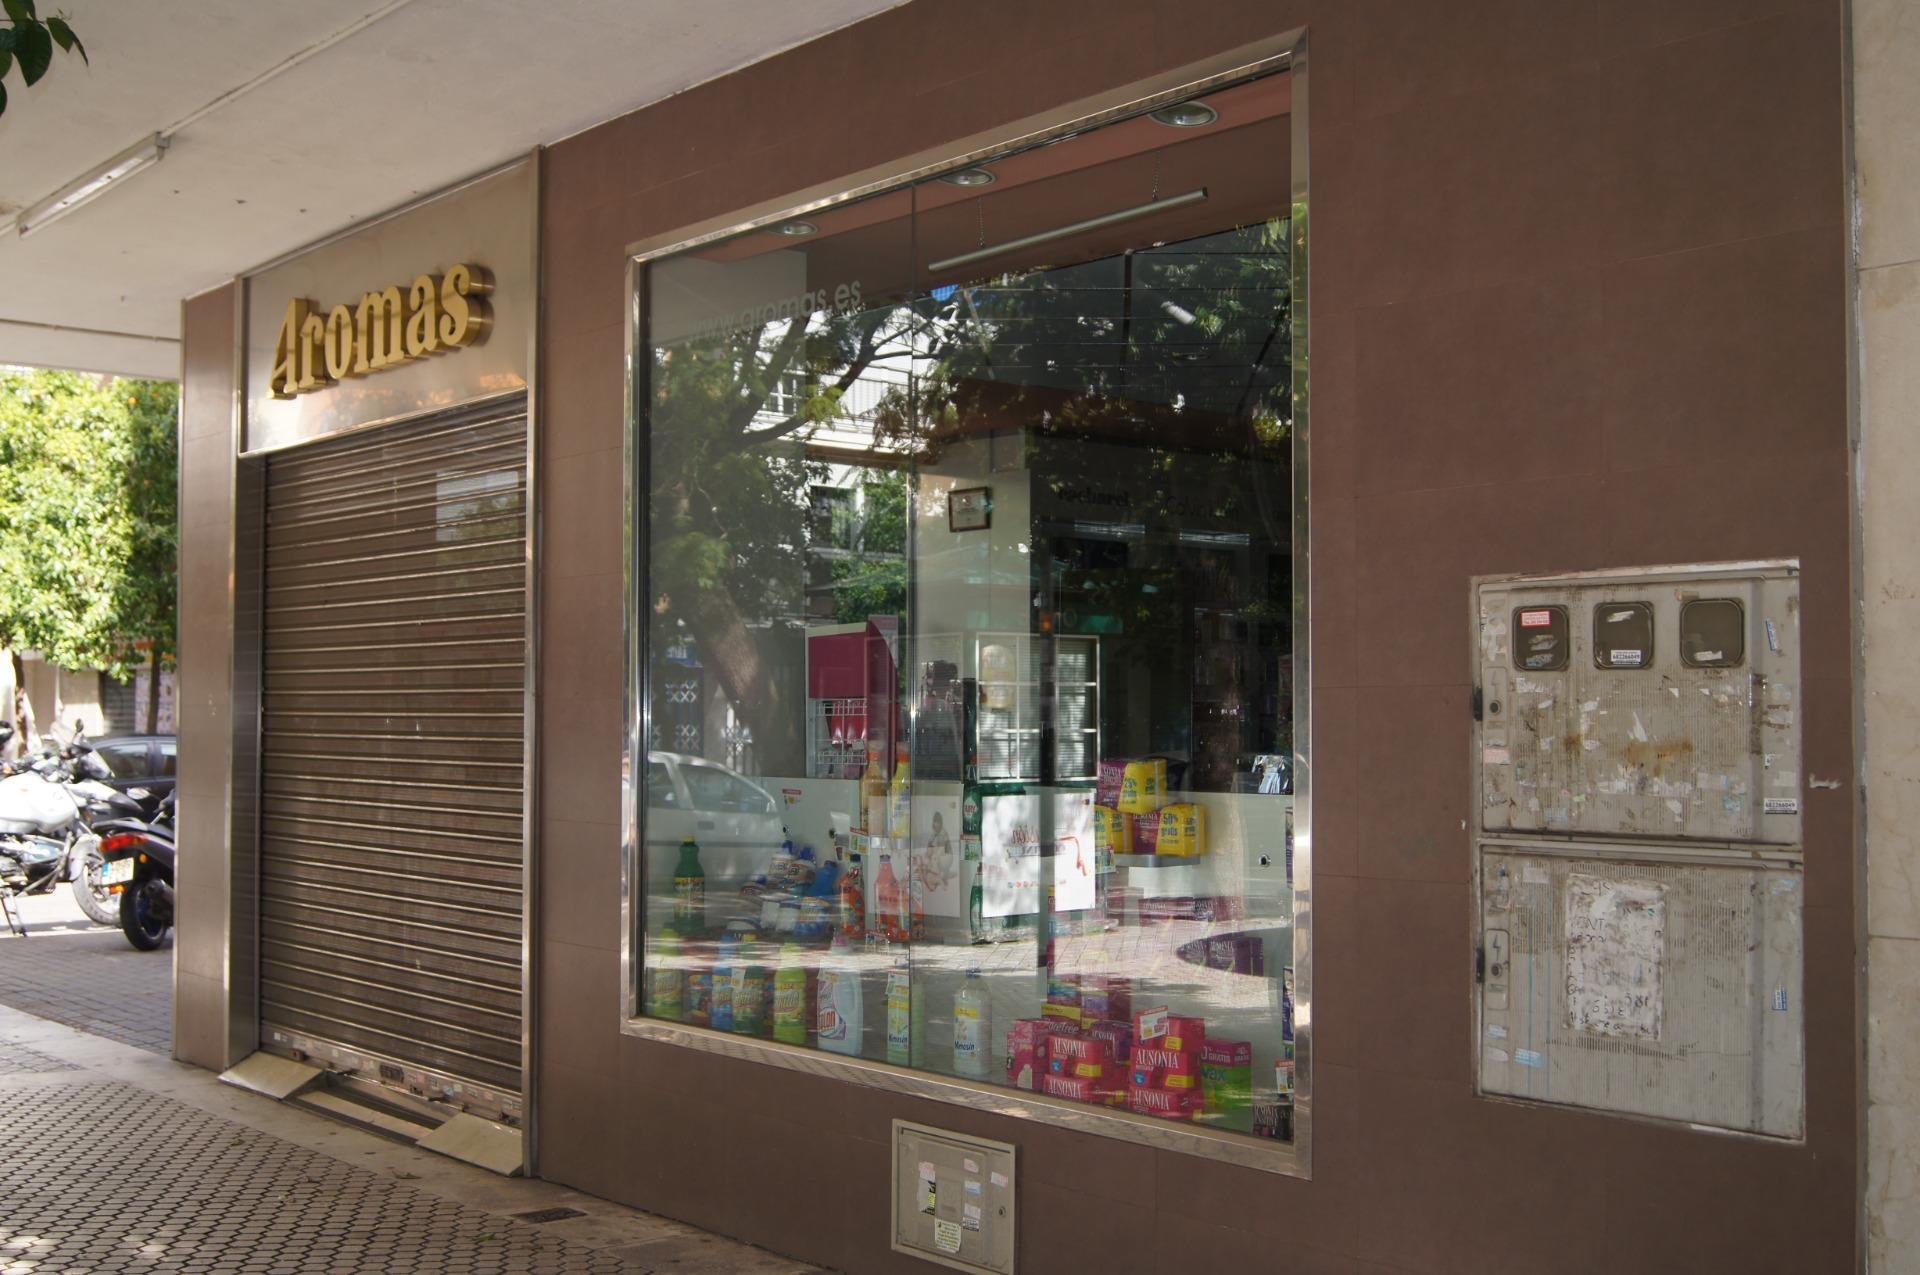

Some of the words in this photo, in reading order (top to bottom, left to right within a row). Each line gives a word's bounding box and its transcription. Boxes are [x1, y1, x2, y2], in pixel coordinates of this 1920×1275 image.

[268, 262, 484, 399] Aromas
[1053, 1037, 1087, 1059] AUSONIA
[1135, 1048, 1179, 1070] AUSONIA
[1048, 1079, 1082, 1099] AUSONIA
[1133, 1089, 1170, 1111] AUSONIA
